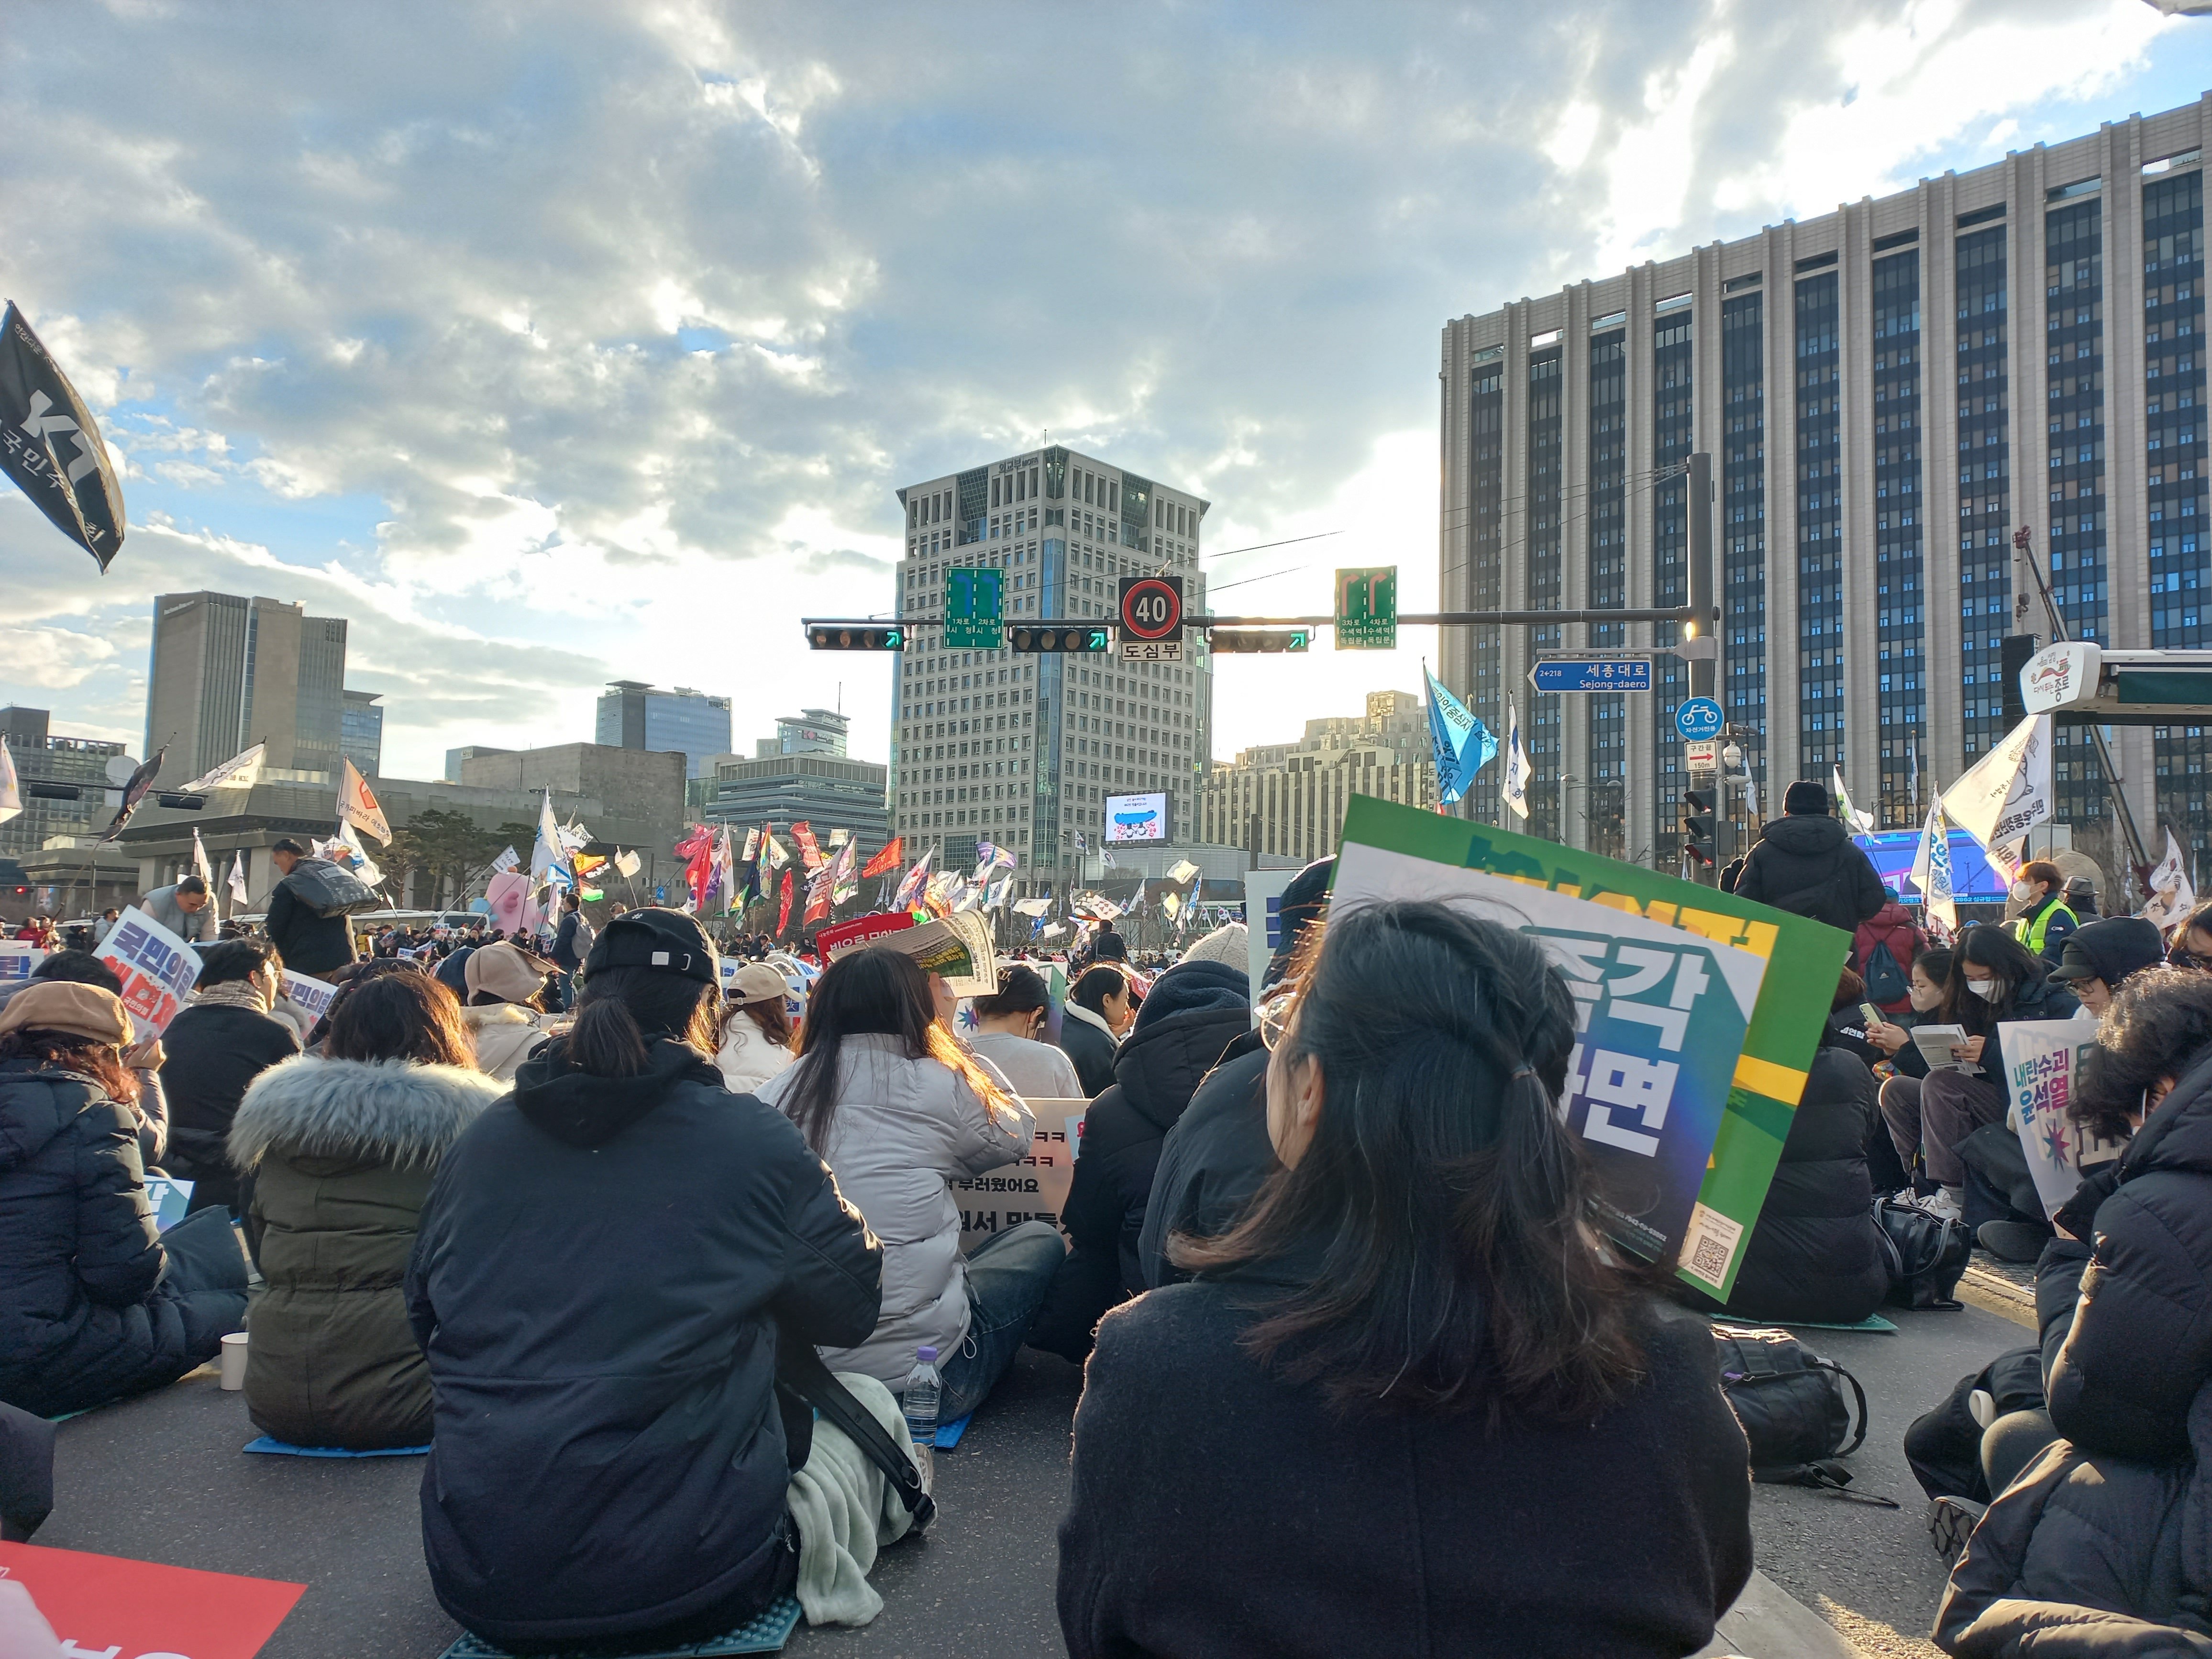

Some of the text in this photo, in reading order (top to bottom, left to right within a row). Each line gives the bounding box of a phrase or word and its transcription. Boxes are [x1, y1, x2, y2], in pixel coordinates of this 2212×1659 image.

[1136, 596, 1167, 622] 40
[1340, 628, 1362, 636] 수색역
[1367, 627, 1390, 635] 수색역
[1340, 637, 1363, 645] 독립문
[1123, 642, 1181, 659] 도심부
[1586, 664, 1647, 678] 세종대로
[1579, 679, 1647, 689] Sejong-daero
[2055, 675, 2069, 702] 종로
[1685, 725, 1716, 733] 자전거전용
[112, 921, 195, 1002] 국민의힘
[2014, 1048, 2069, 1088] 내란수괴
[2019, 1074, 2069, 1125] 윤석열
[958, 1177, 1039, 1193] 부러웠어요
